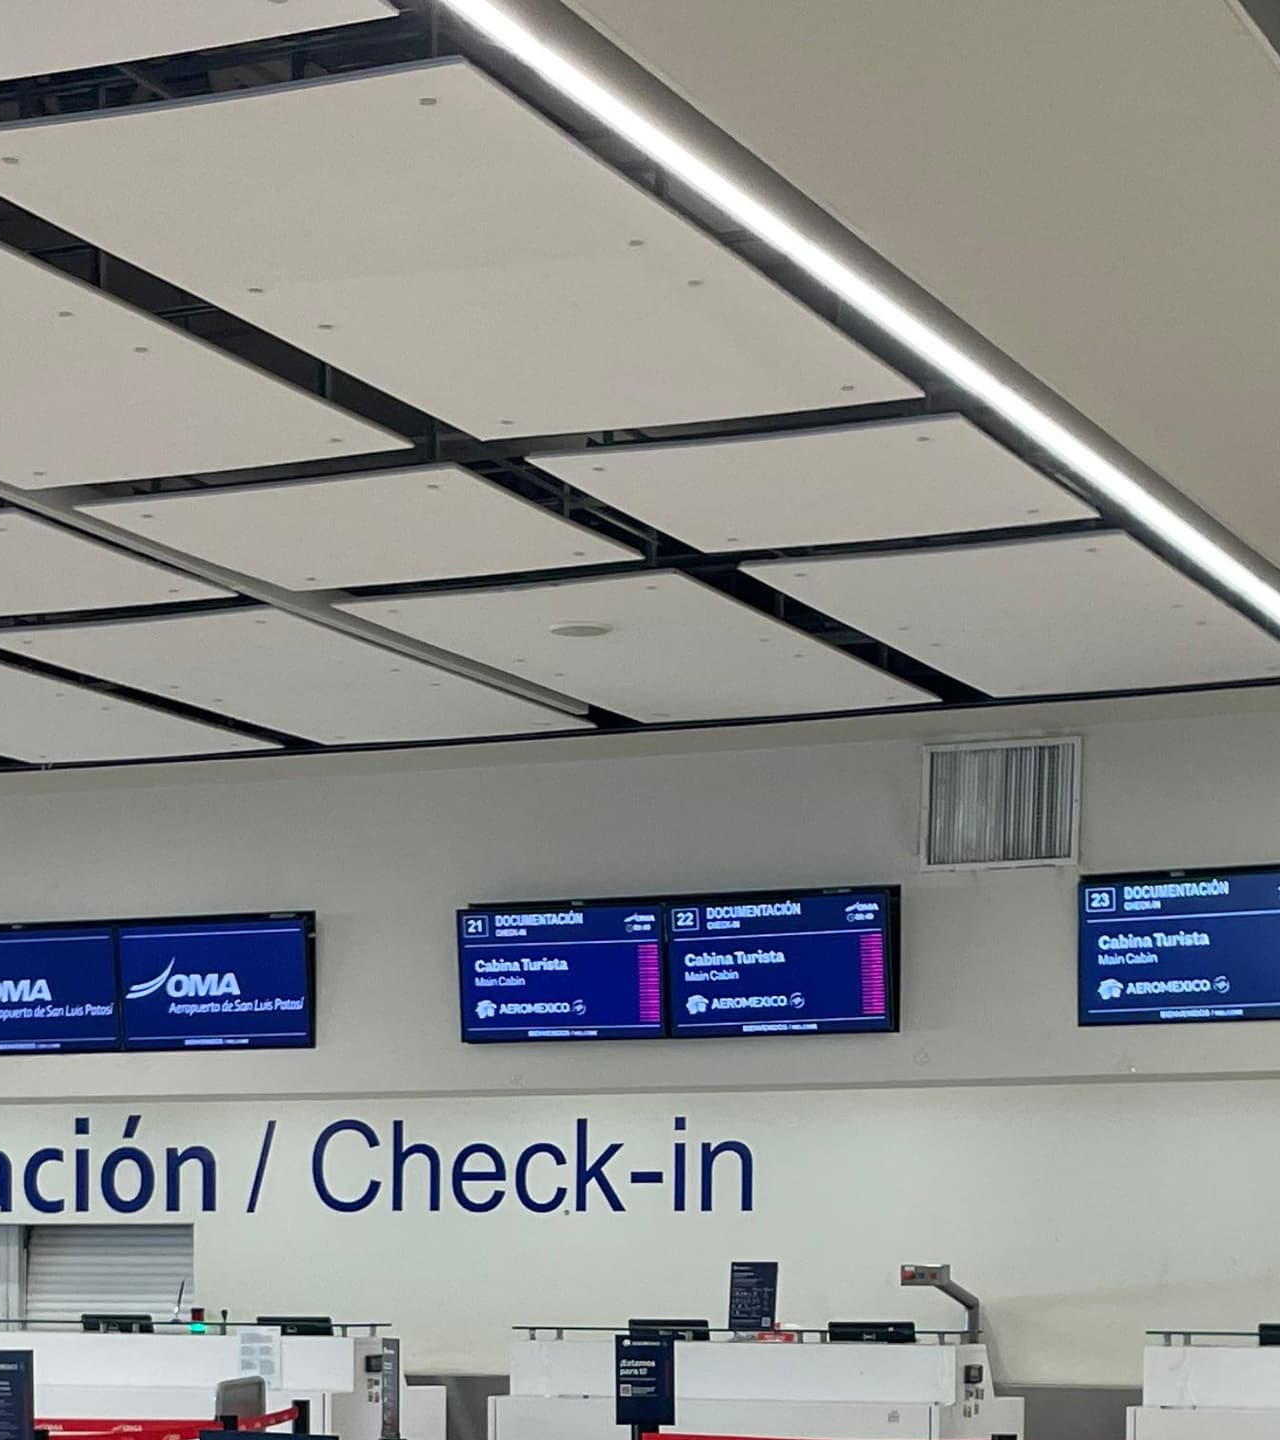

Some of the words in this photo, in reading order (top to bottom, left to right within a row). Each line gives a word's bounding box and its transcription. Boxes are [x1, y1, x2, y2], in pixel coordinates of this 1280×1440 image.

[1090, 893, 1110, 908] 23
[1124, 879, 1229, 900] DOCUMENTACIÓN
[676, 912, 694, 926] 22
[706, 900, 801, 919] DOCUMENTACIÓN
[467, 920, 483, 933] 21
[495, 910, 584, 927] DOCUMENTACIÓN
[1098, 935, 1152, 950] Cabina
[1153, 931, 1210, 947] Turista
[475, 959, 520, 973] Cabina
[520, 957, 569, 971] Turista
[685, 952, 734, 967] Cabina
[735, 950, 785, 964] Turista
[1098, 954, 1125, 965] Main
[1126, 952, 1158, 964] Cabin
[475, 977, 497, 986] Main
[498, 976, 526, 986] Cabin
[685, 971, 709, 982] Main
[710, 969, 739, 981] Cabin
[165, 972, 240, 998] OMA
[1126, 980, 1211, 994] AEROMEXICO
[34, 1003, 45, 1018] de
[46, 1004, 64, 1018] San
[66, 1003, 84, 1017] Luis
[169, 999, 219, 1017] Aeropuerto
[221, 999, 233, 1013] de
[234, 999, 252, 1013] San
[254, 998, 272, 1012] Luis
[499, 1002, 570, 1015] AEROMEXICO
[711, 996, 788, 1010] AEROMEXICO
[311, 1118, 755, 1213] Check-in
